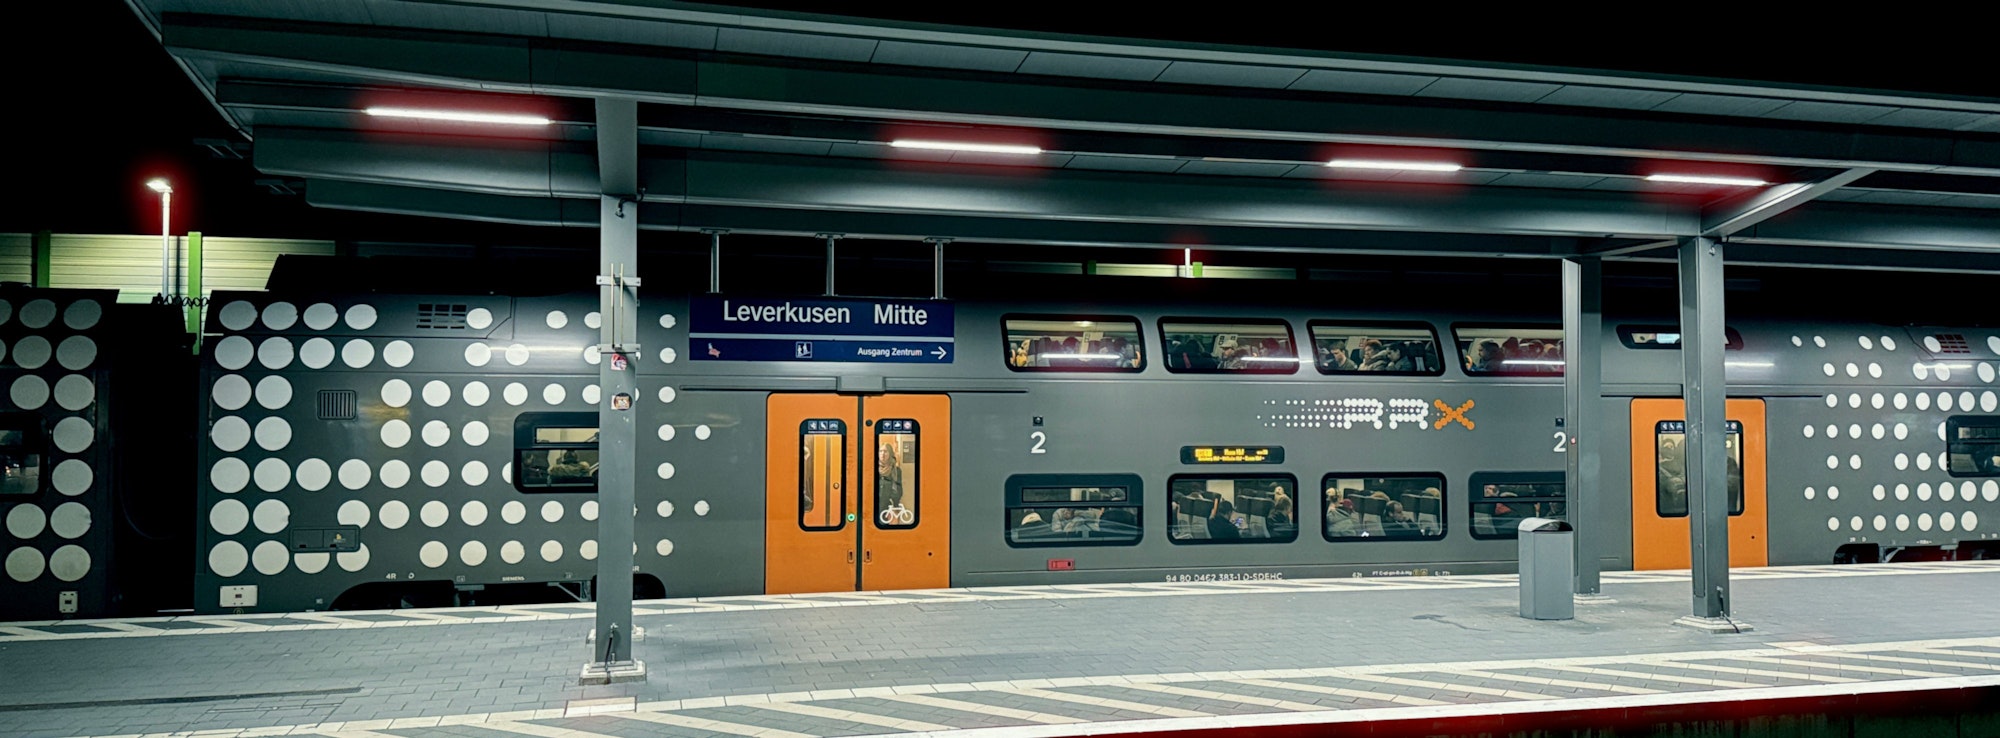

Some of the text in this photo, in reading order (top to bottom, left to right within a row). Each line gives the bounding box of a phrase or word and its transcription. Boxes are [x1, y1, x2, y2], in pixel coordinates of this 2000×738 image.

[723, 300, 928, 325] Leverkusen Mitte
[857, 347, 923, 358] Ausgang Zentrum
[1343, 398, 1475, 430] RRX
[1030, 431, 1046, 454] 2
[1553, 431, 1567, 453] 2
[1165, 574, 1177, 583] 94
